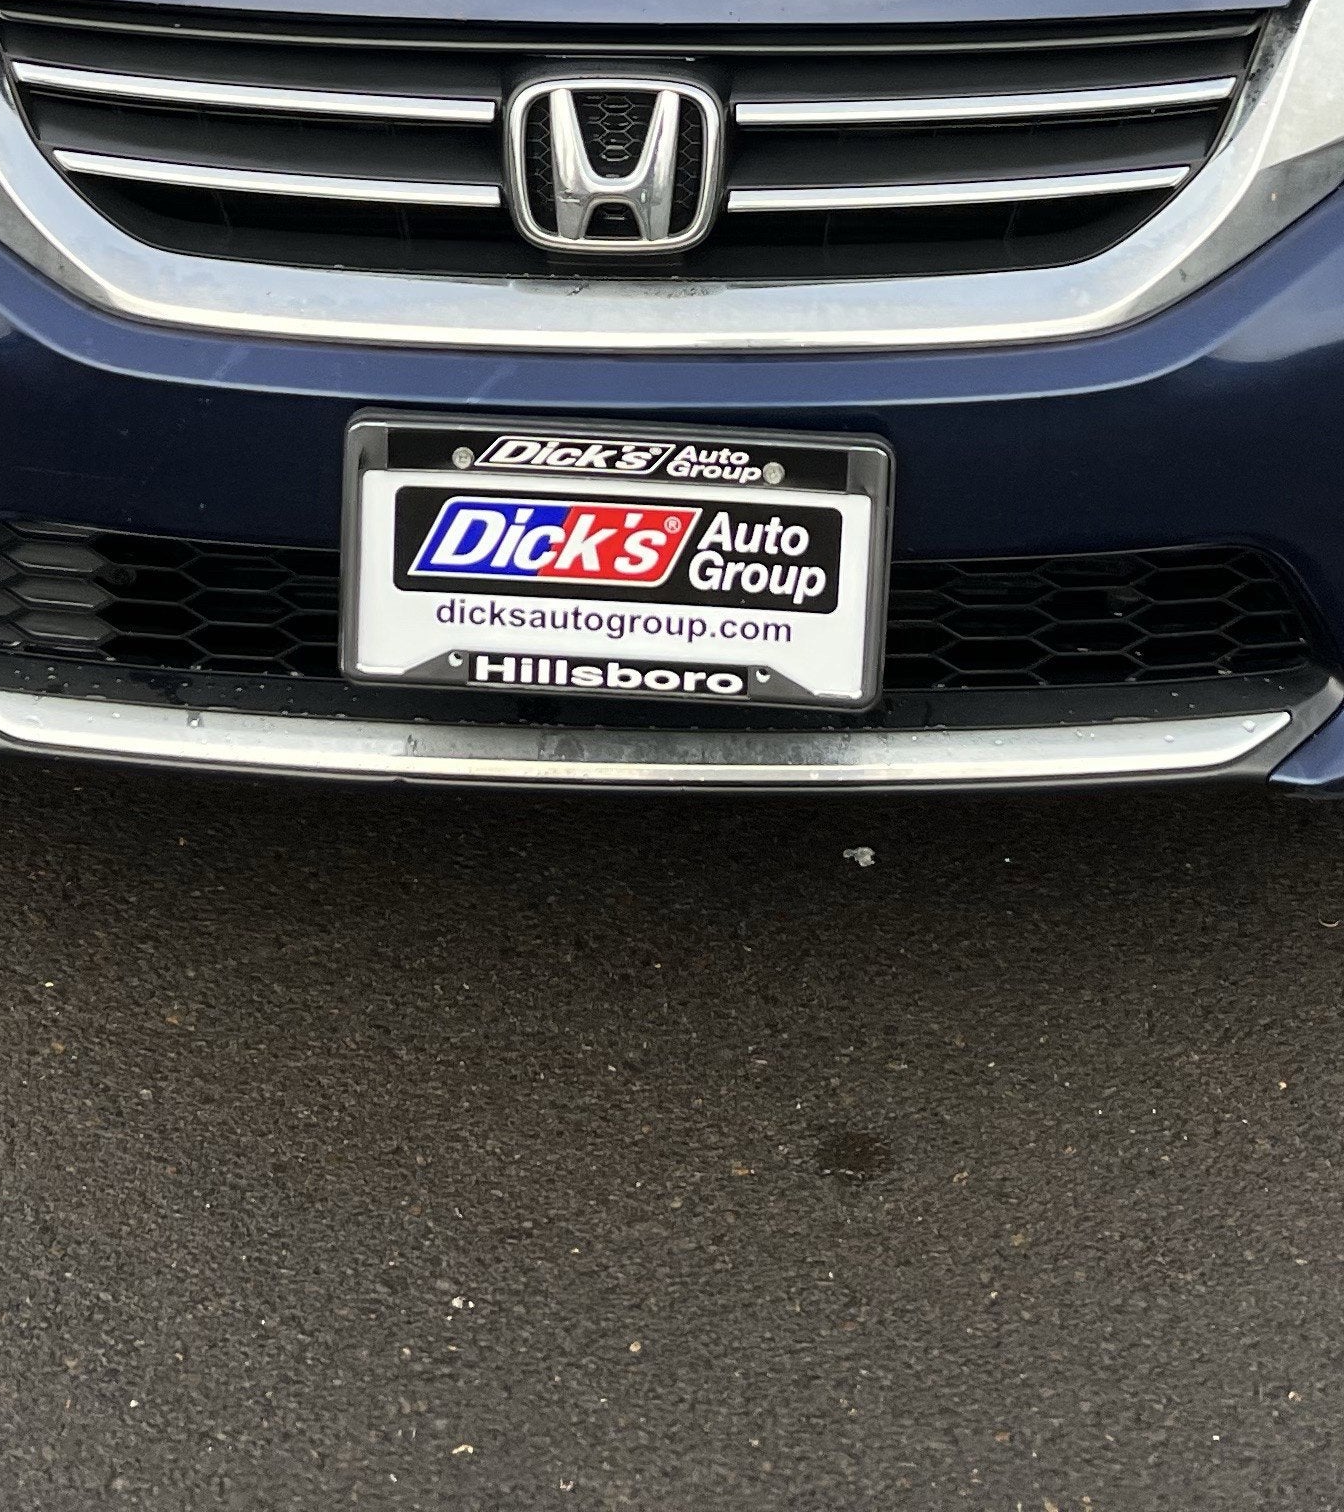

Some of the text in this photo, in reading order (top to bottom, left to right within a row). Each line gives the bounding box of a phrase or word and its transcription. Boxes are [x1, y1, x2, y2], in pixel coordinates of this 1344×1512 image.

[488, 440, 655, 470] Dick's
[666, 460, 762, 483] Group
[673, 444, 750, 466] Auto
[696, 511, 810, 557] Auto
[688, 551, 827, 604] Group
[436, 598, 793, 643] dicksautogroup.com
[474, 654, 744, 694] Hillsboro
